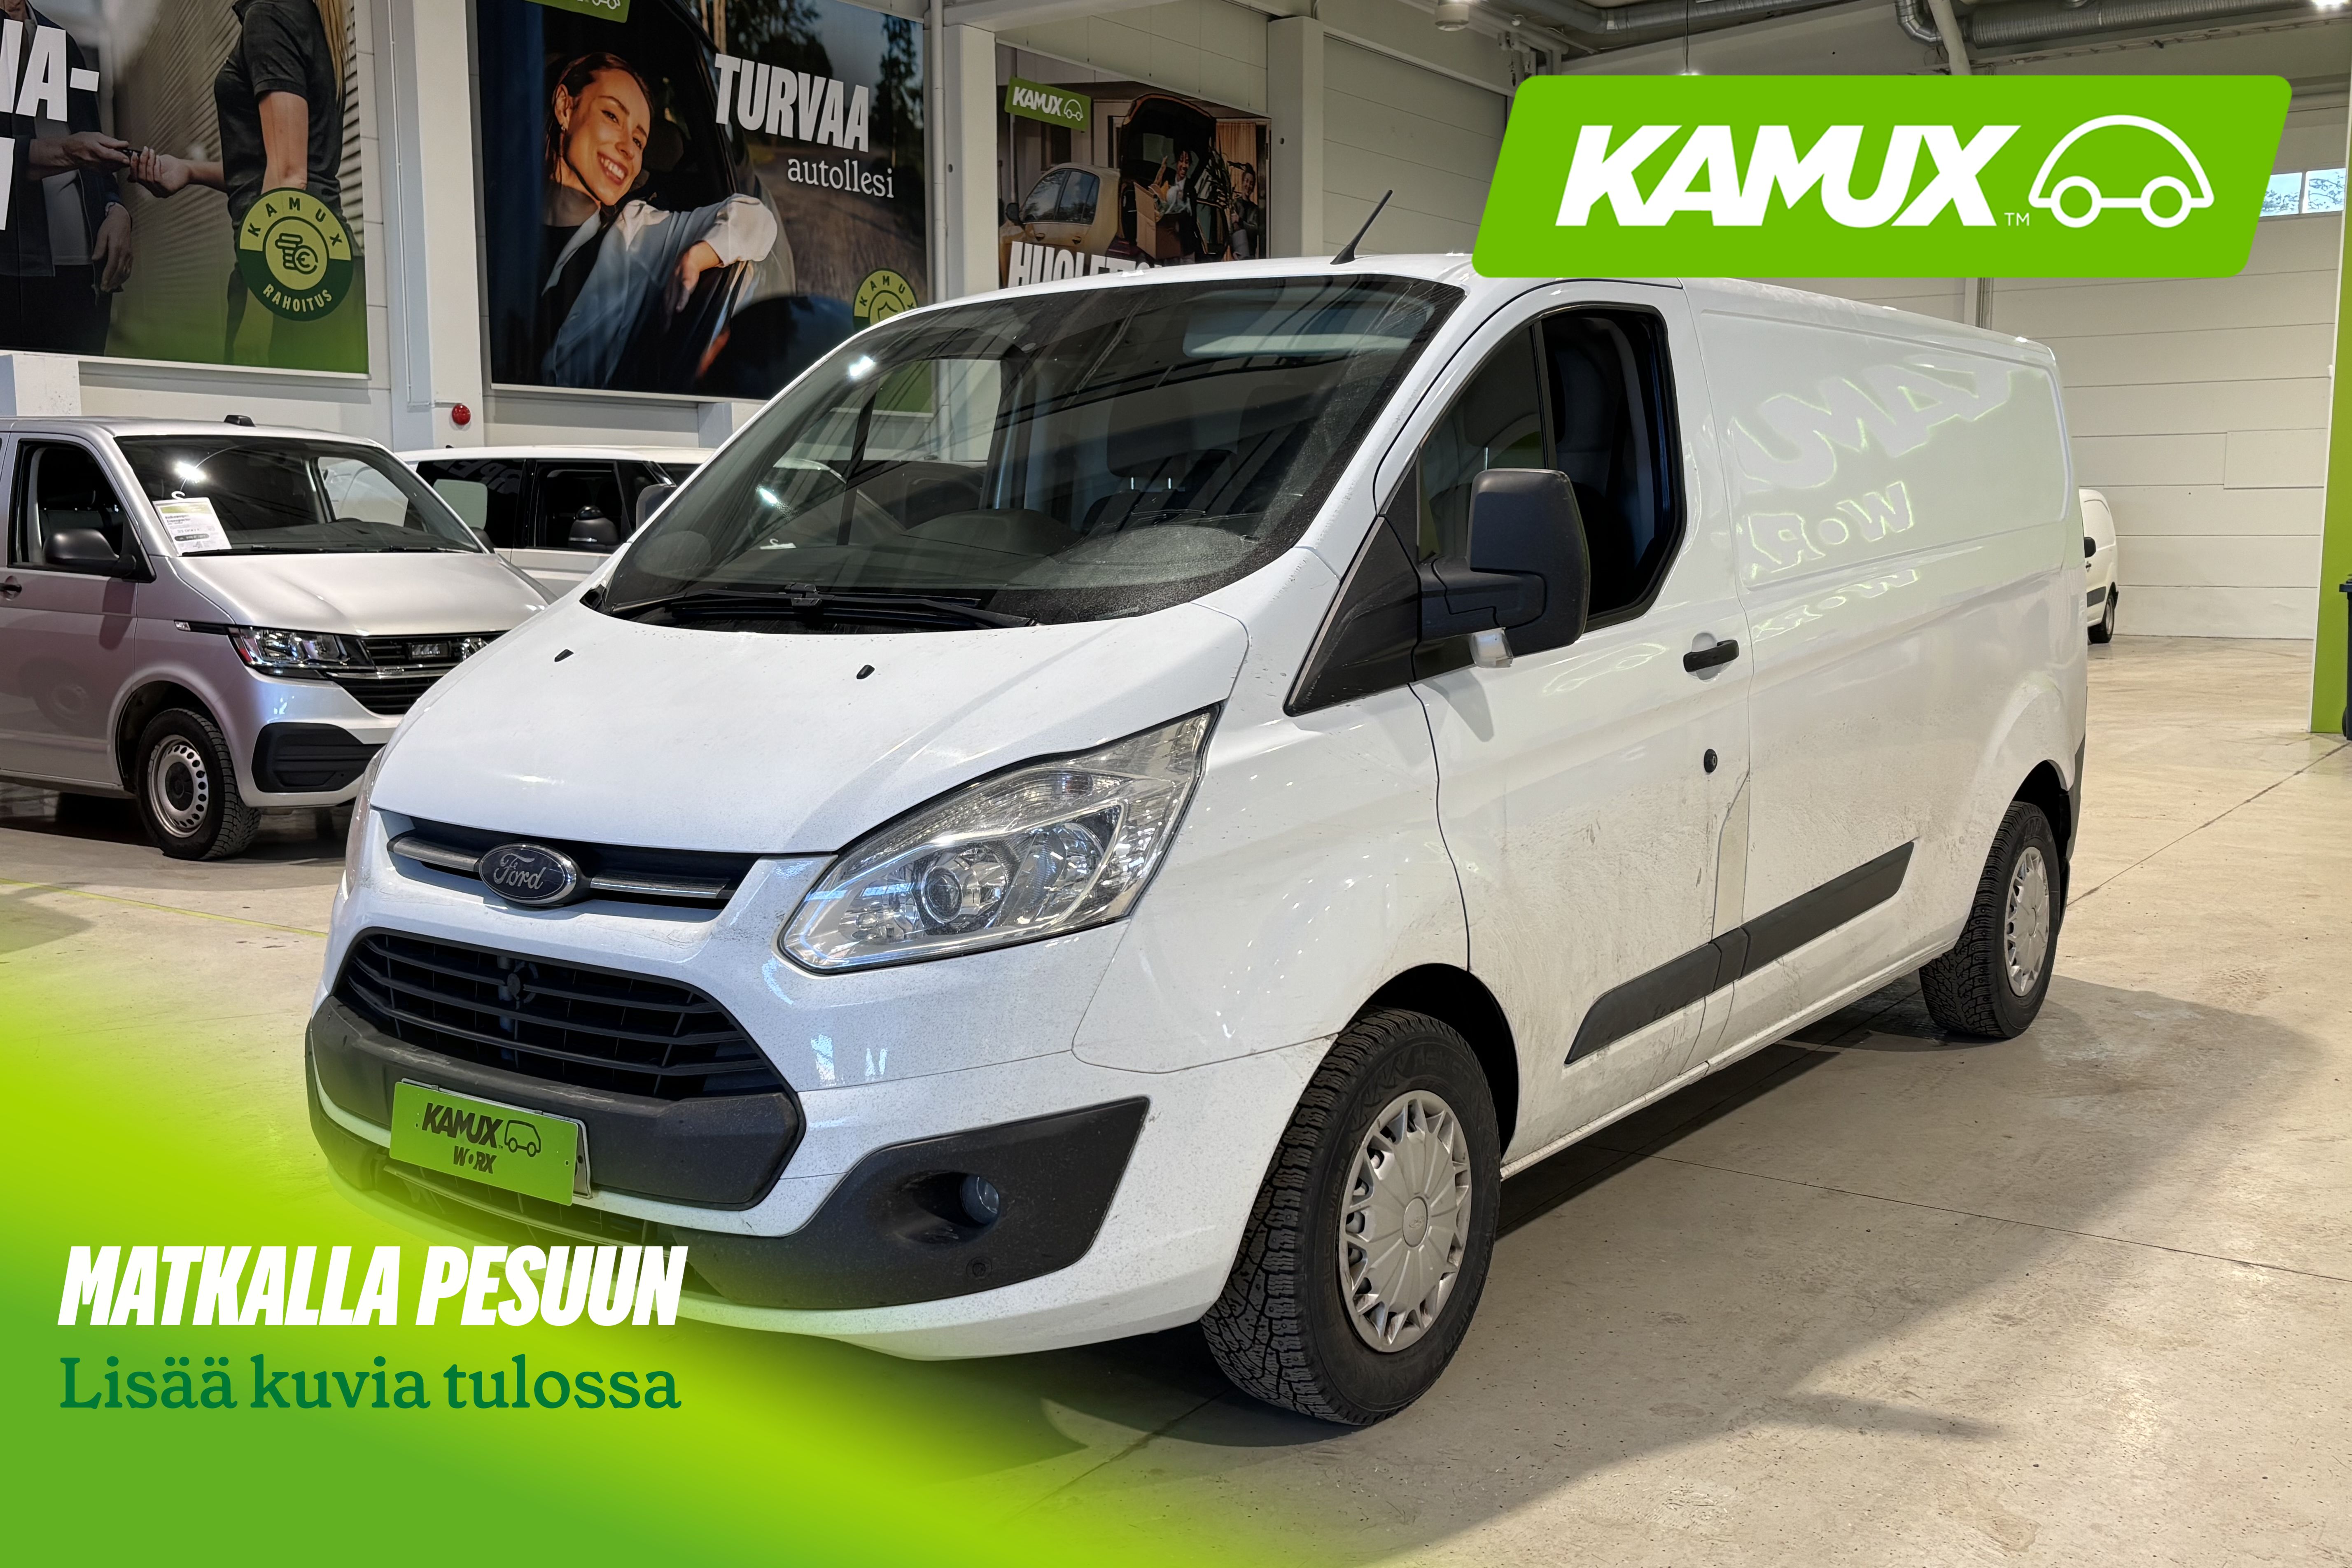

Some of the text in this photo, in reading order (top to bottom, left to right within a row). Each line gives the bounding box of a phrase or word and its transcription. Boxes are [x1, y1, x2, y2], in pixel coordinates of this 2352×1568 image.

[715, 53, 869, 152] TURVAA
[1012, 86, 1064, 117] KAMUX
[787, 159, 894, 198] autollesi
[247, 197, 343, 247] KAMUX
[263, 284, 332, 312] RAHOITUS
[859, 275, 915, 310] KAMUX
[493, 853, 547, 889] Ford
[421, 1102, 503, 1148] KAMUX
